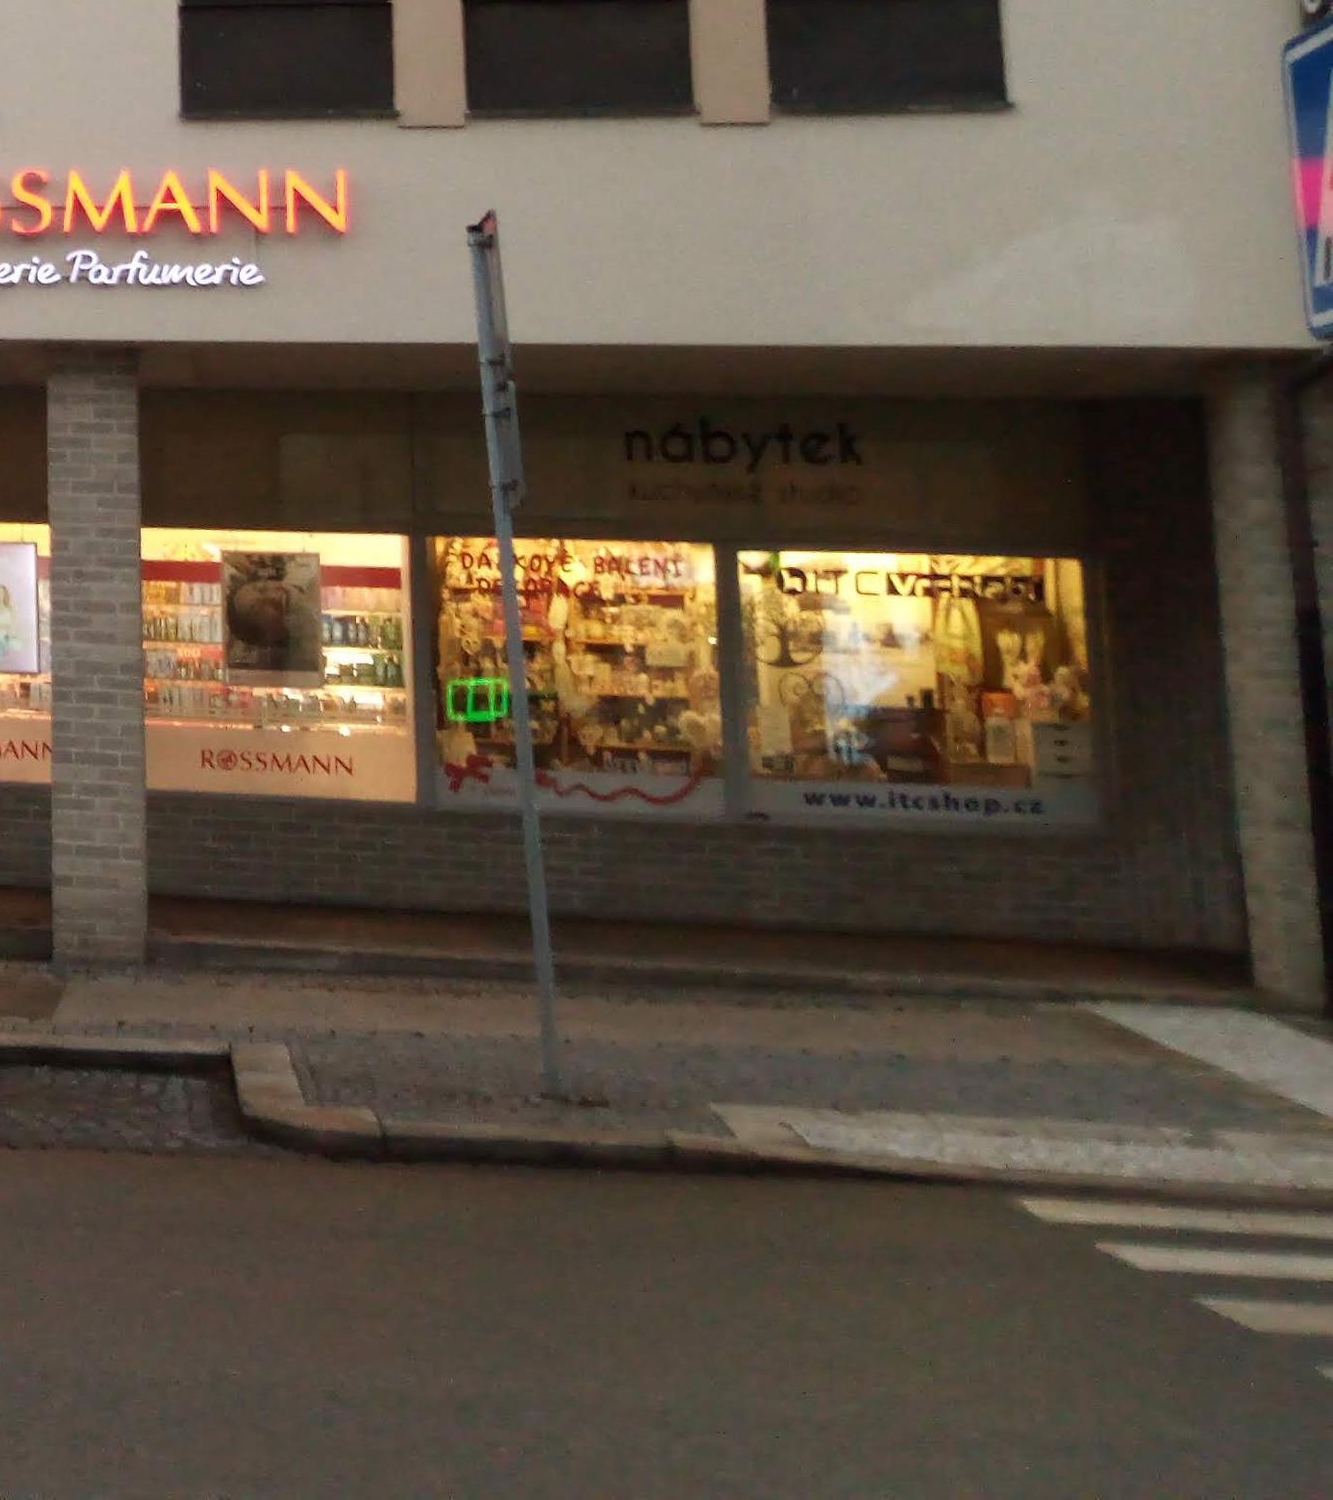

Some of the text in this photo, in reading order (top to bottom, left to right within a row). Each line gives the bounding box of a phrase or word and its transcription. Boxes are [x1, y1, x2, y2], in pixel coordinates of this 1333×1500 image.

[66, 247, 265, 288] Parfumerie
[624, 414, 864, 473] nábytek
[200, 748, 354, 776] ROSSMANN
